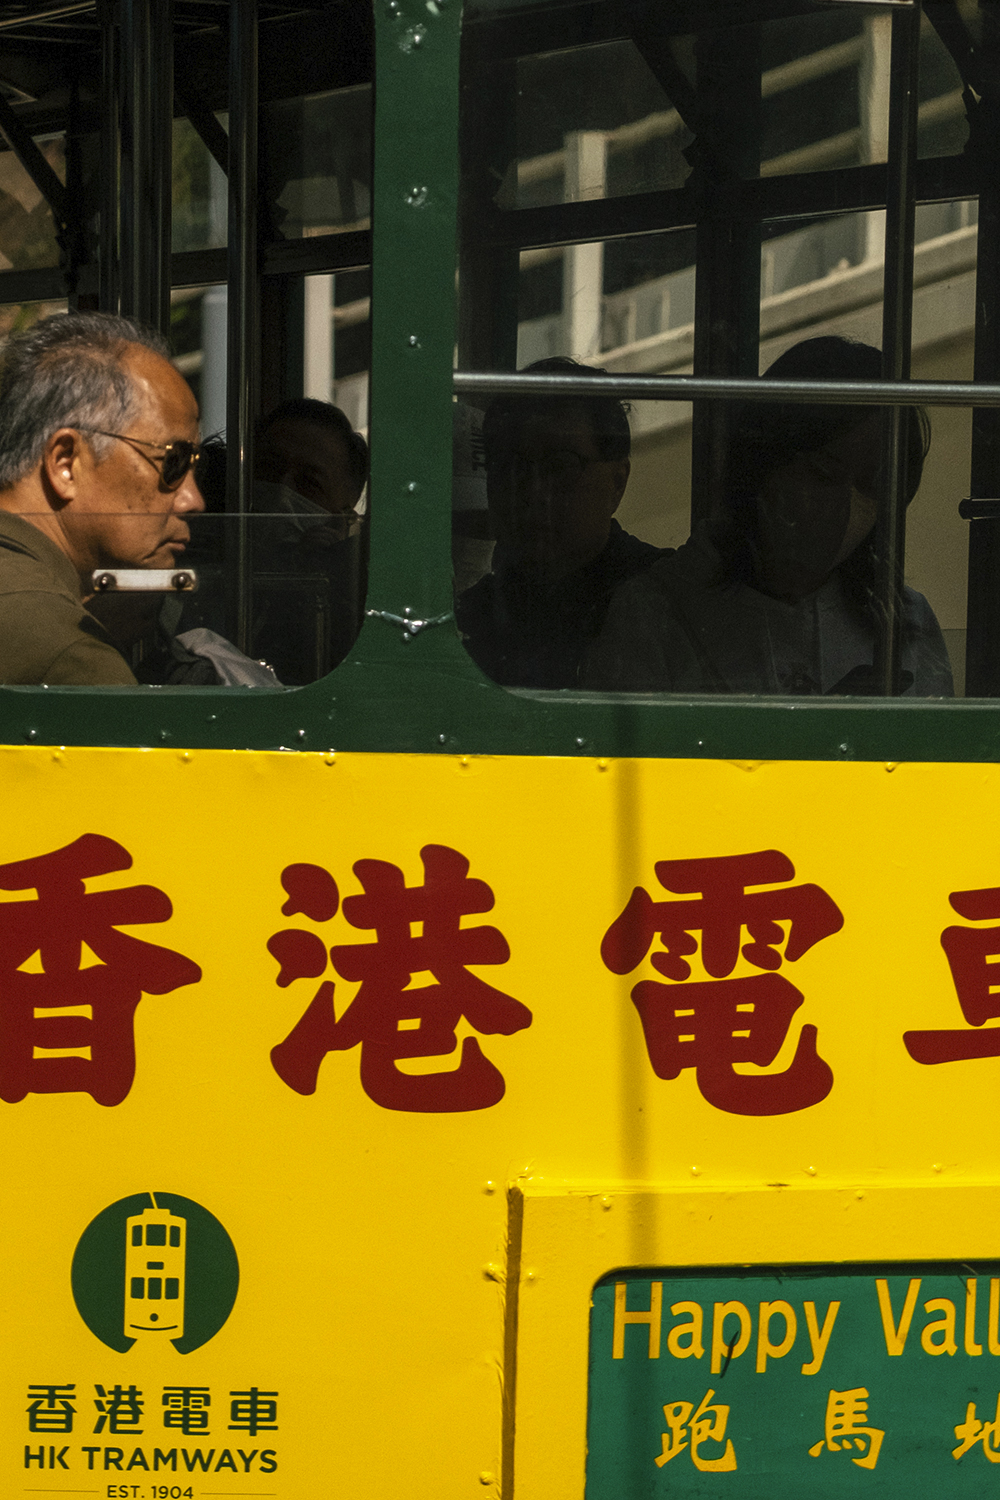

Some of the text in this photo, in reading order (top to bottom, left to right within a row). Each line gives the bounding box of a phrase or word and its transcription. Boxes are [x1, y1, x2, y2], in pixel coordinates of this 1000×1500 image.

[612, 1280, 842, 1376] Happy
[25, 1383, 279, 1437] 香港電車
[23, 1445, 279, 1474] HK TRAMWAYS
[106, 1484, 195, 1500] EST. 1904
